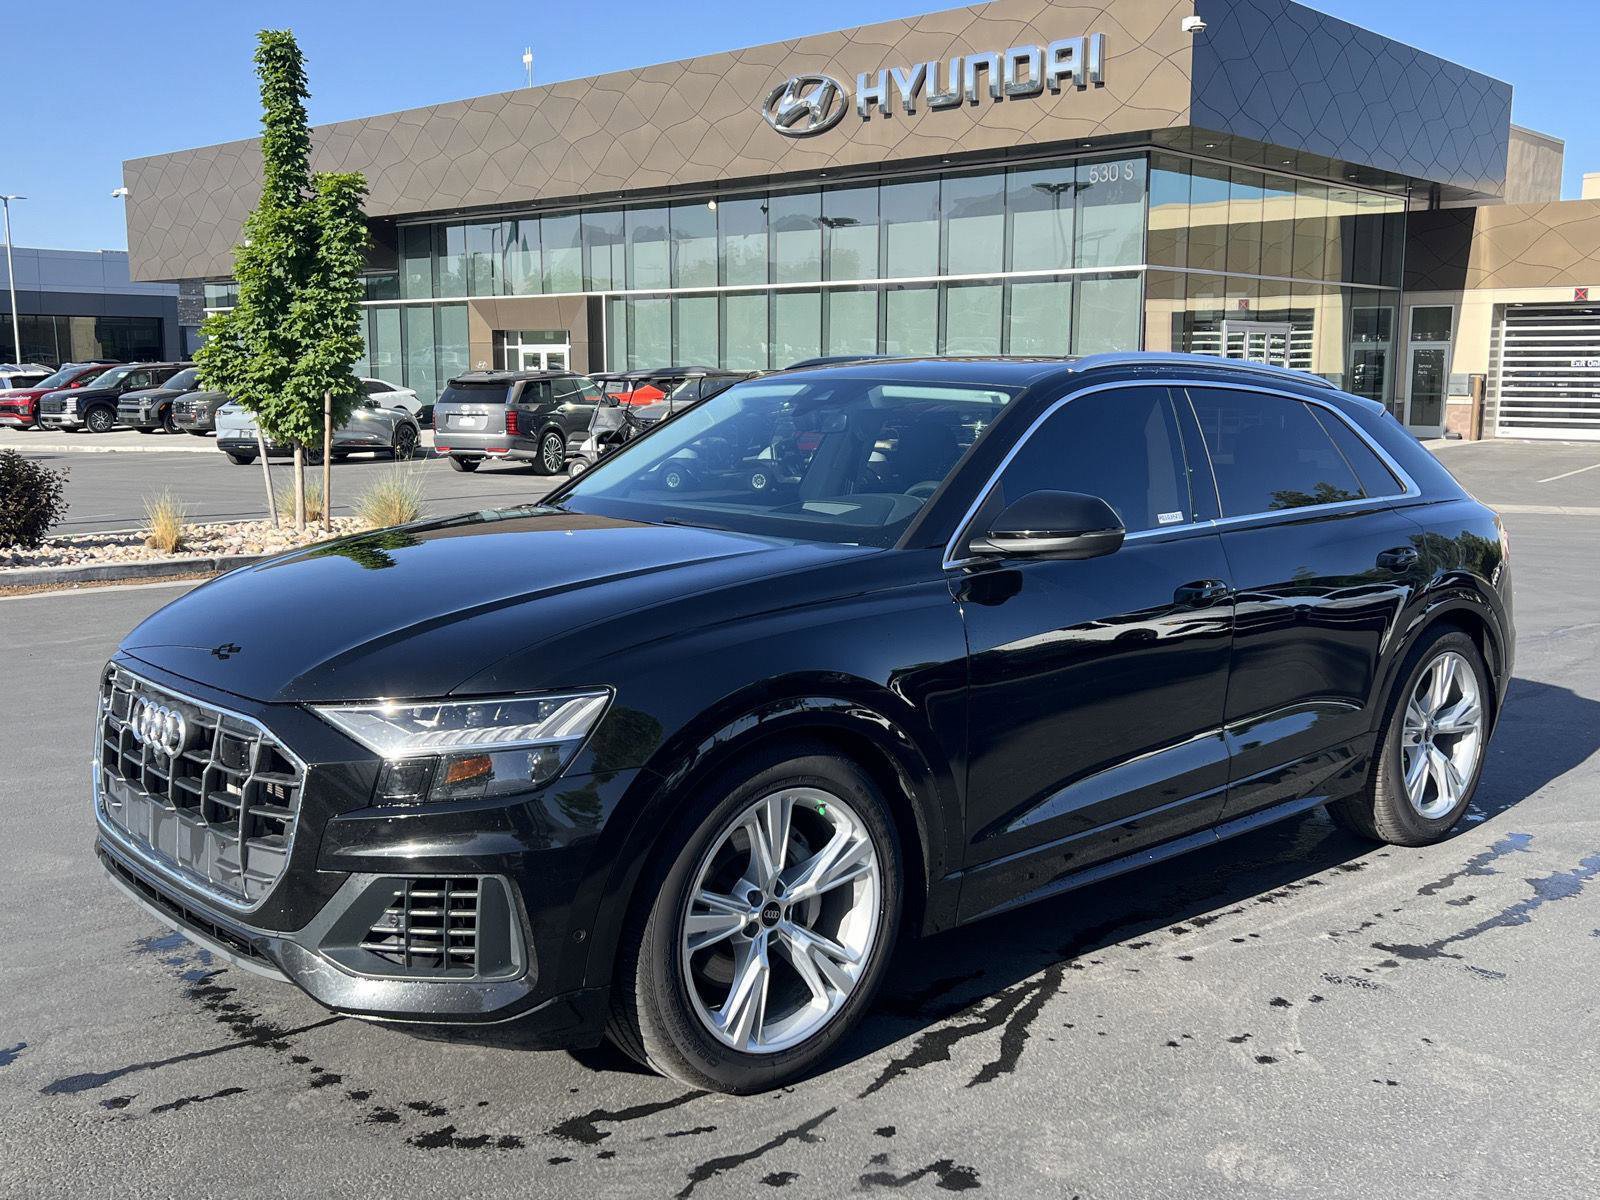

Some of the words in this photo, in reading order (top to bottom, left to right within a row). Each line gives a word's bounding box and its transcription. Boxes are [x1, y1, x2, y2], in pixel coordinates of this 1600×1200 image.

[856, 33, 1105, 121] HYUNDAI
[1089, 163, 1119, 184] 530
[1124, 161, 1134, 181] S
[1571, 359, 1586, 367] Exit
[1587, 359, 1600, 367] Onl
